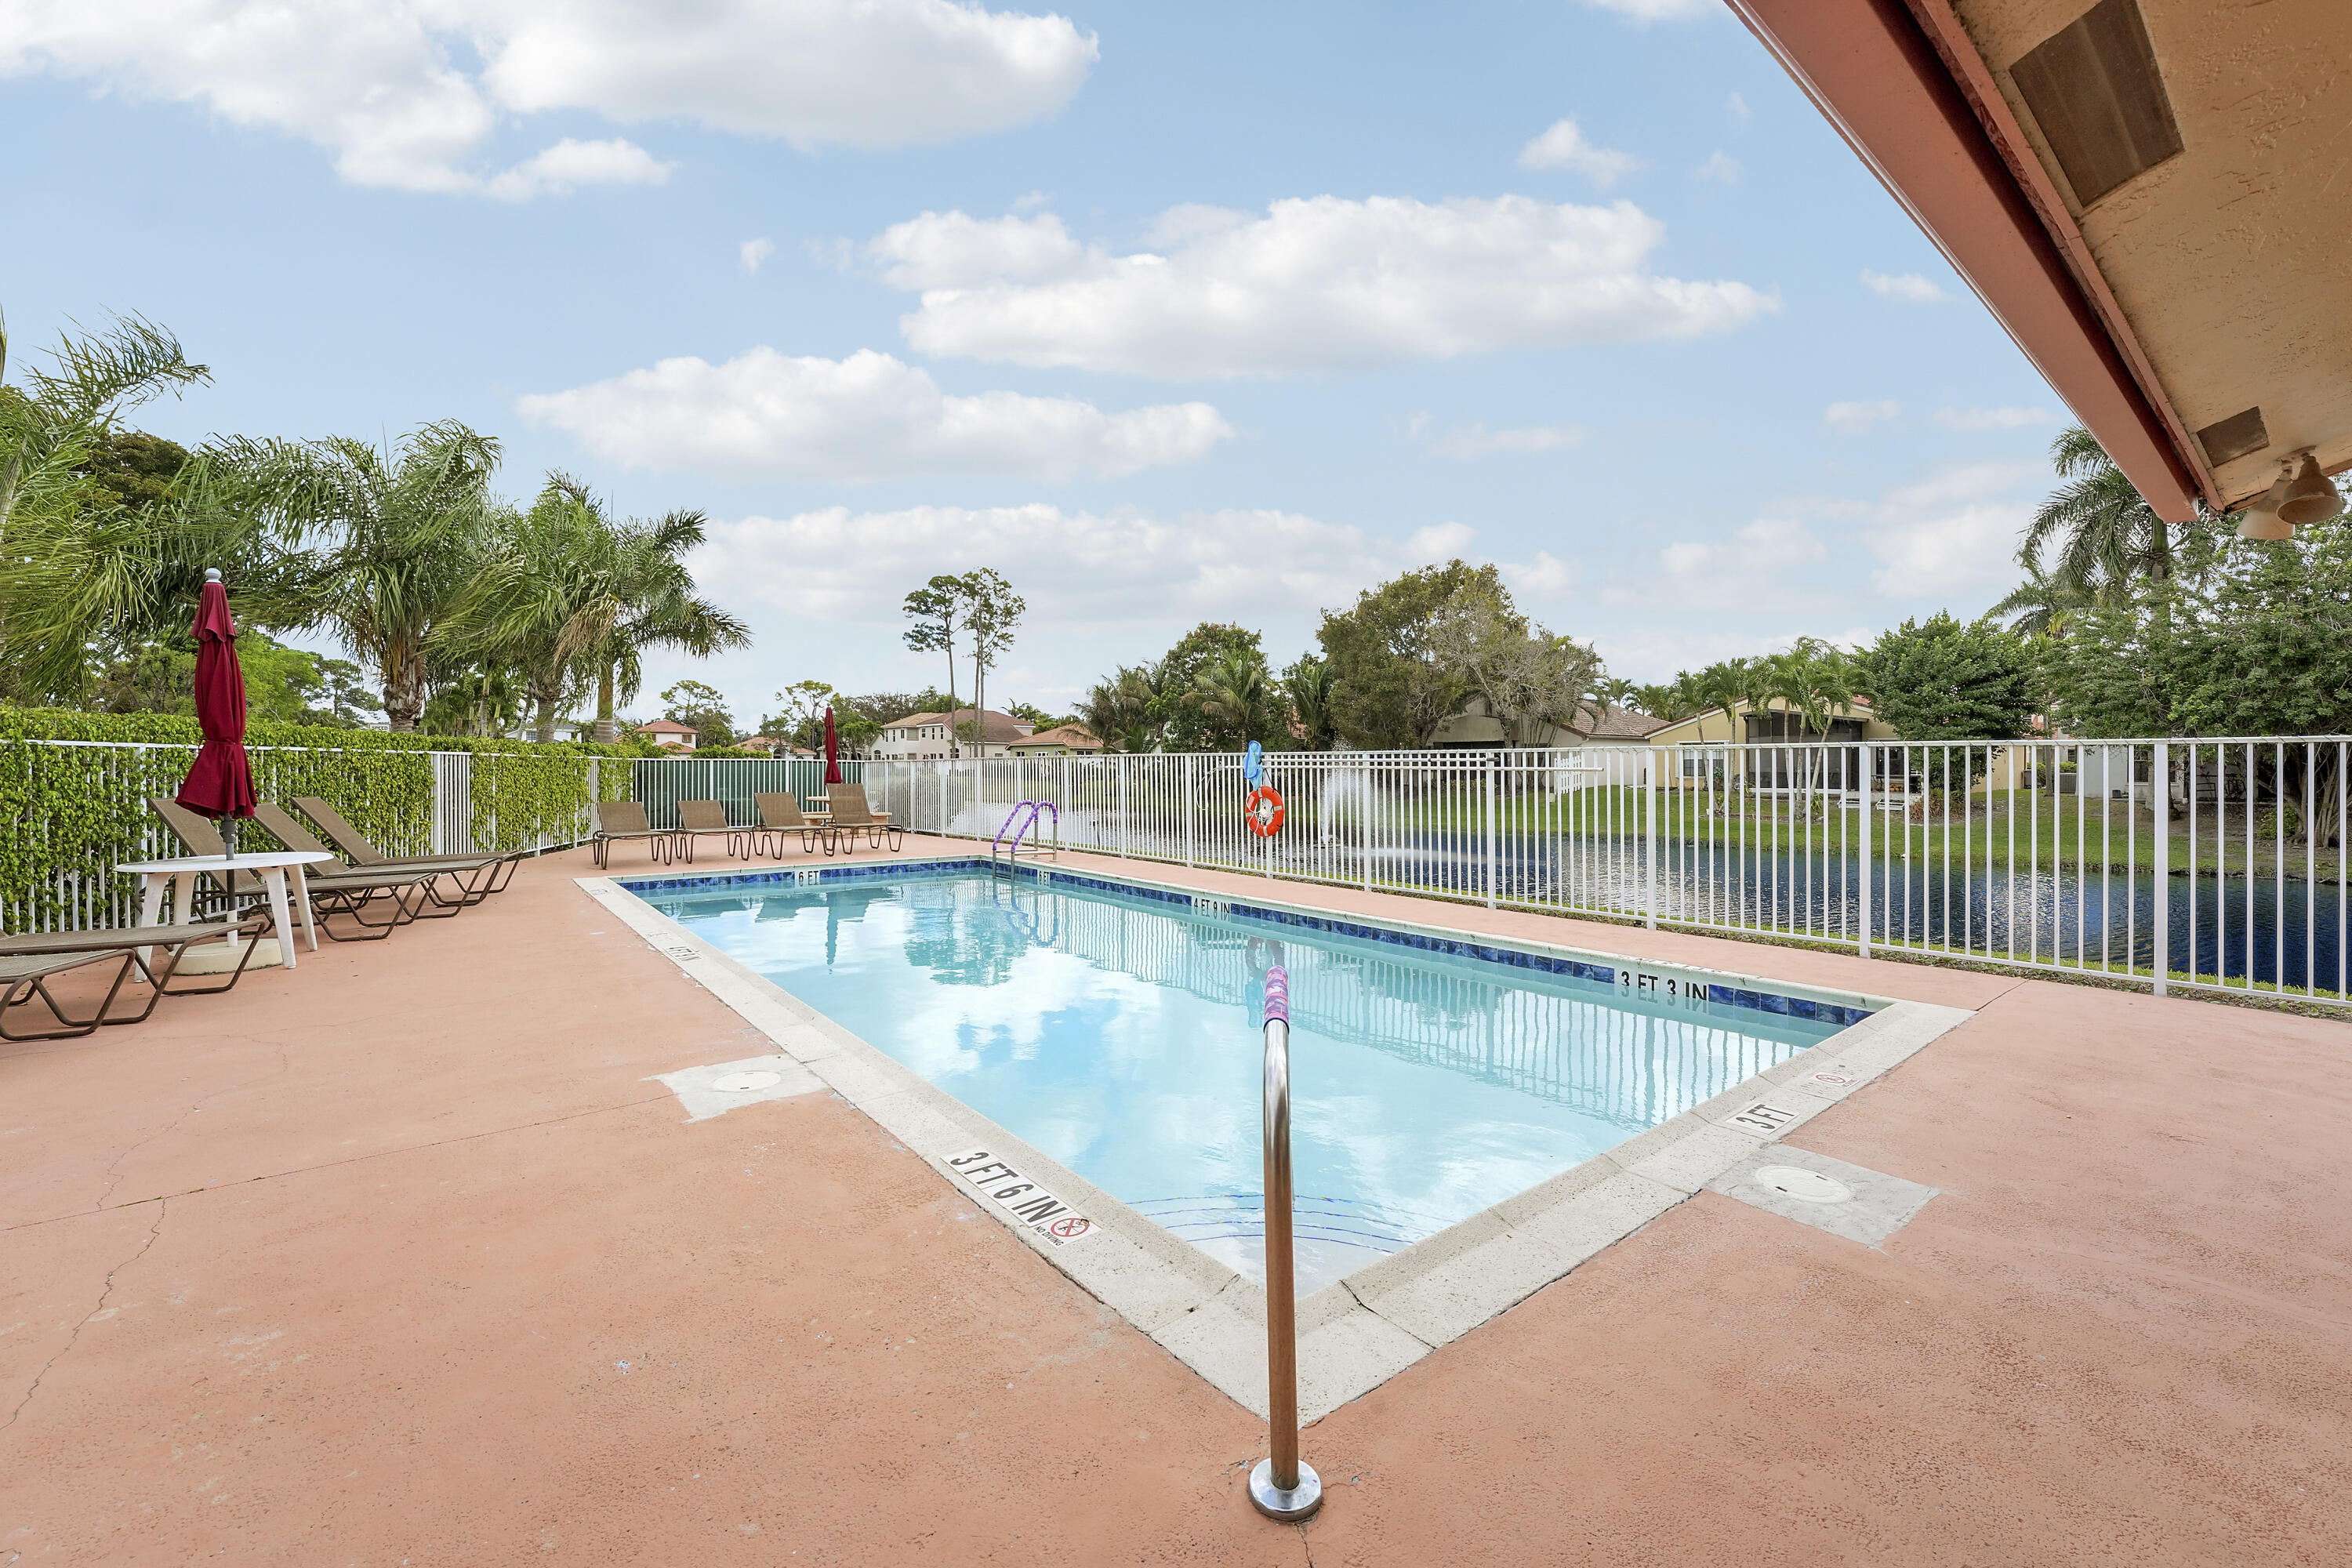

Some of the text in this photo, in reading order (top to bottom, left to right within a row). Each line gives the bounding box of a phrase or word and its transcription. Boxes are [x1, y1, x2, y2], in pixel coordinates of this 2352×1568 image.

[1221, 902, 1229, 913] IN
[1621, 971, 1707, 1000] 3 FT 3 IN
[1736, 1104, 1795, 1130] 3 FT
[950, 1152, 1068, 1223] 3 FT 6 IN
[1042, 1232, 1064, 1247] DIVING
